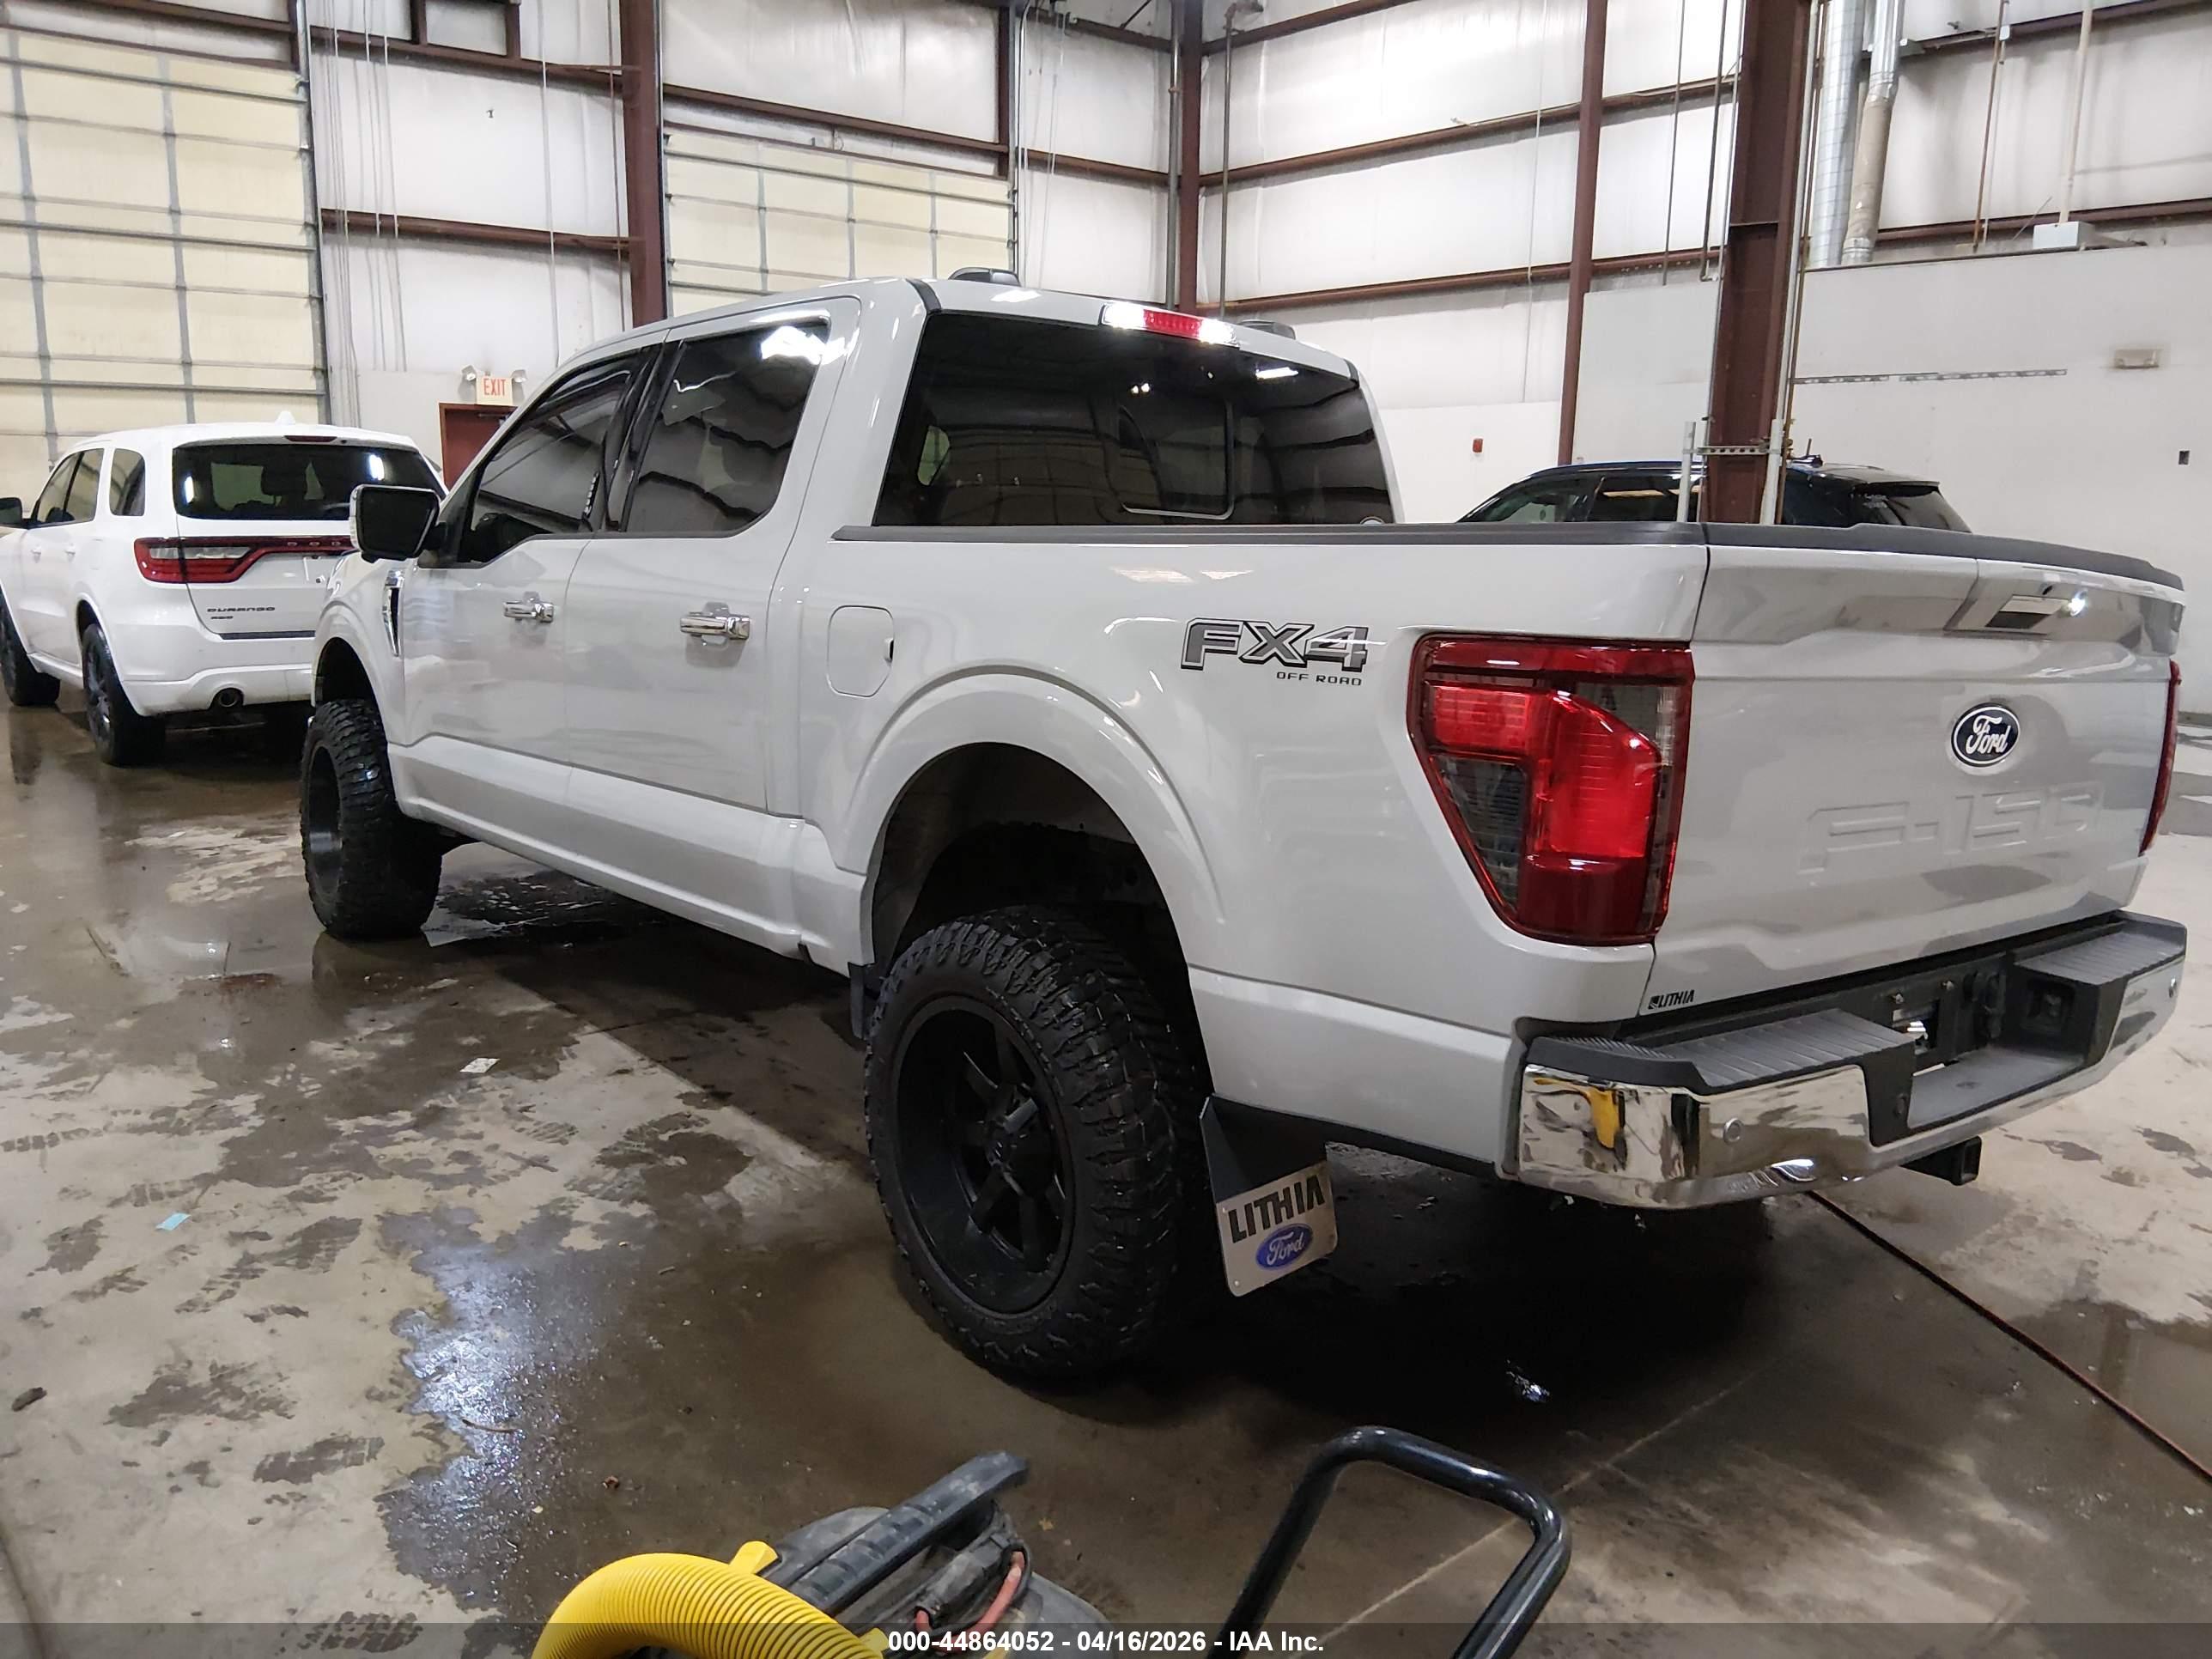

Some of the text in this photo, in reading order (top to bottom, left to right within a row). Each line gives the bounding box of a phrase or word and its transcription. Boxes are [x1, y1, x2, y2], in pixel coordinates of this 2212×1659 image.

[483, 378, 506, 396] EXIT
[1181, 617, 1369, 673] FX4
[1276, 672, 1362, 687] OFF ROAD
[1965, 714, 2012, 756] Ford
[1798, 781, 2105, 875] F-150
[1657, 989, 1695, 1008] LITHIA
[1228, 1174, 1326, 1244] LITHIA
[1266, 1231, 1305, 1266] Ford
